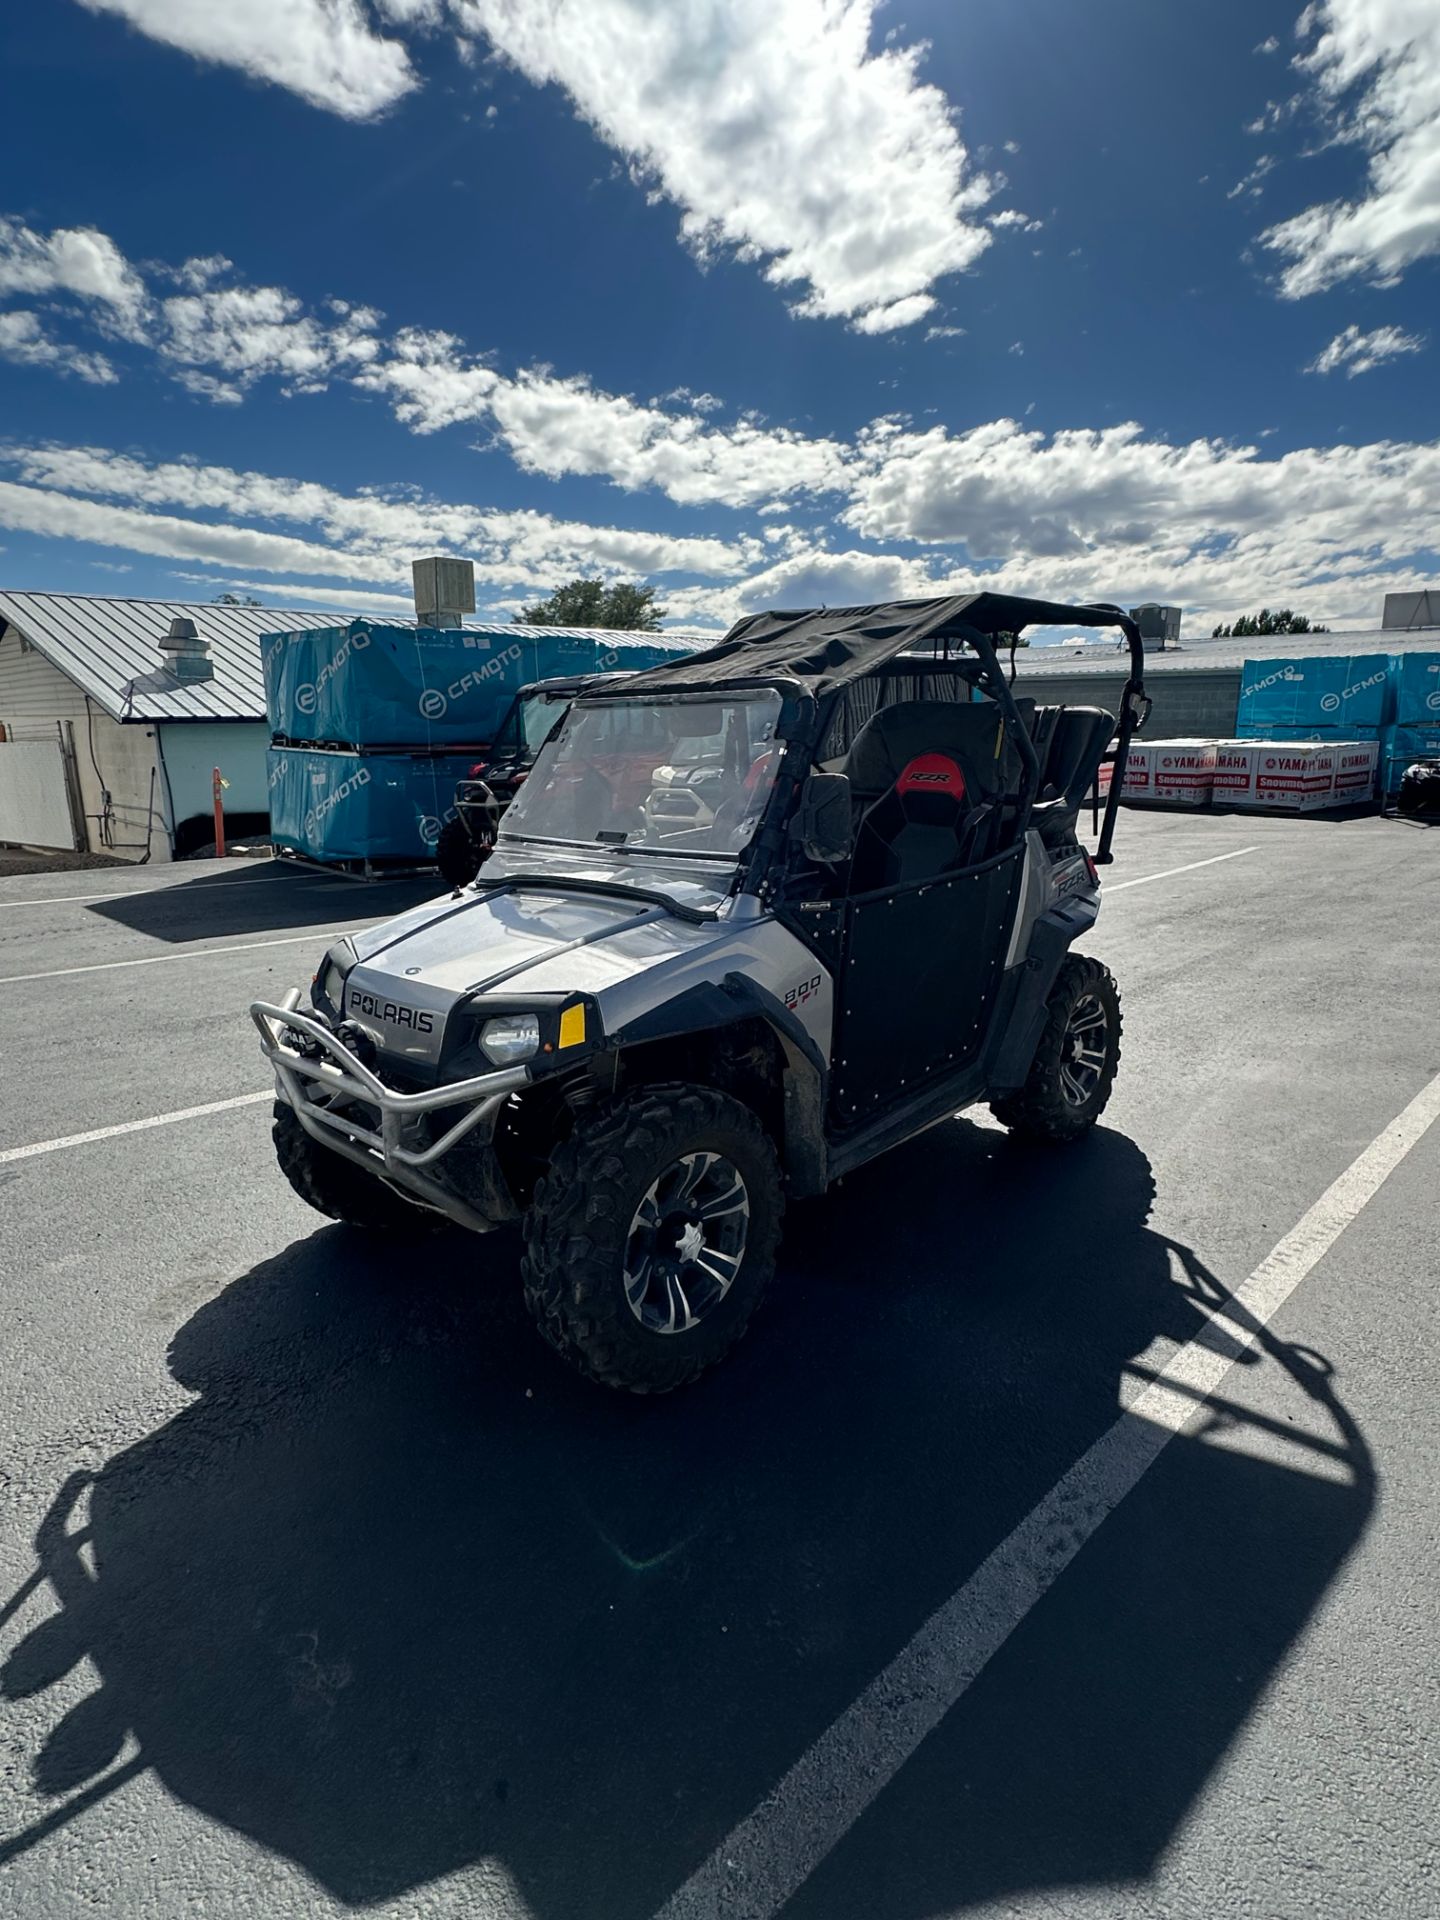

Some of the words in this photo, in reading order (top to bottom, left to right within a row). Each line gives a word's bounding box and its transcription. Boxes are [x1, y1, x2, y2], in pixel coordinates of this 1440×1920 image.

[315, 632, 371, 694] CFMOTO
[447, 643, 522, 700] CFMOTO
[1241, 665, 1296, 700] FMOTO
[315, 767, 372, 821] CFMOTO
[906, 772, 951, 783] RZR
[1057, 870, 1086, 897] RZR
[785, 974, 822, 1004] 800
[350, 991, 435, 1034] POLARIS
